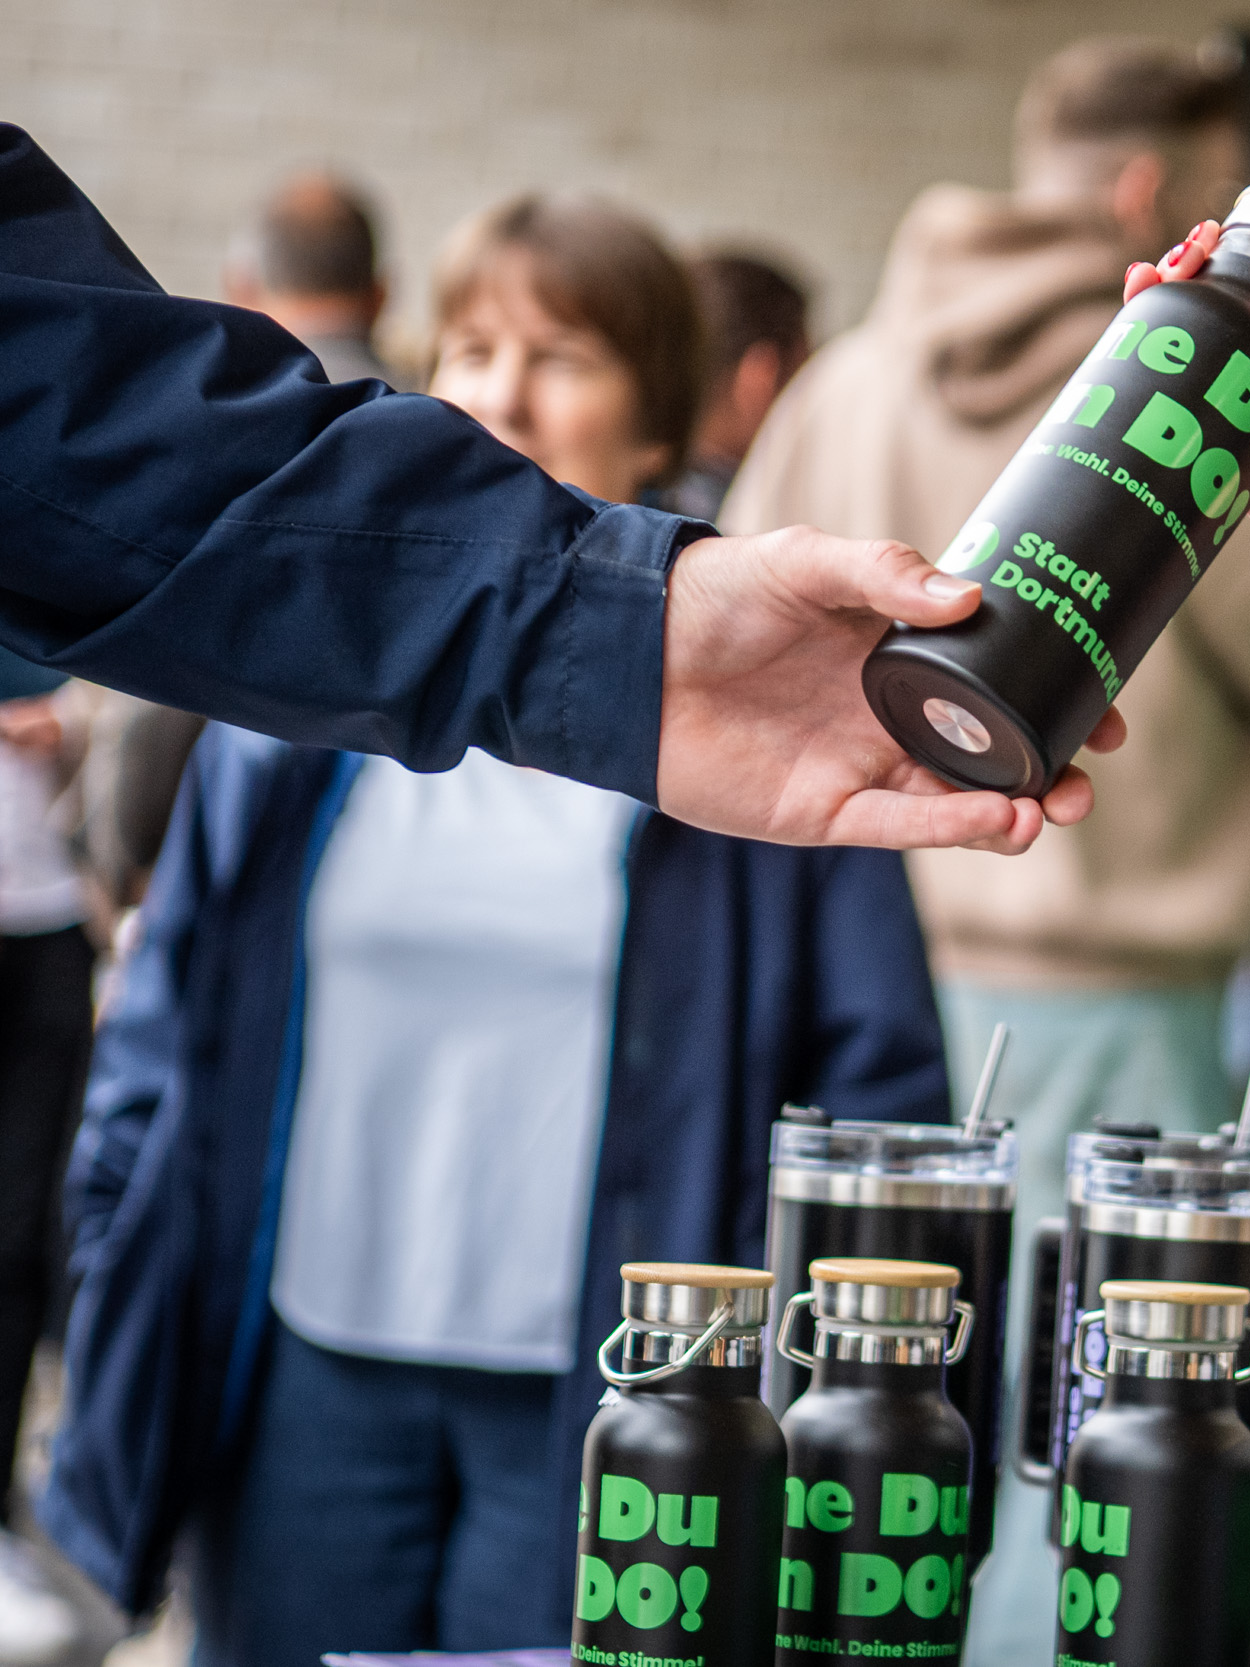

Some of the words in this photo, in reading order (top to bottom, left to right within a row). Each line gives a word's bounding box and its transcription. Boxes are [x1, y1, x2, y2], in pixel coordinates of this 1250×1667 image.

[1056, 443, 1110, 477] Wahl.
[1111, 466, 1165, 516] Deine
[1121, 391, 1250, 546] DO!
[1013, 532, 1111, 612] Stadt
[990, 559, 1124, 705] Dortmund
[598, 1474, 719, 1548] Du
[879, 1473, 968, 1538] Du
[576, 1553, 710, 1633] DO!
[837, 1552, 963, 1619] DO!
[1060, 1567, 1122, 1638] O!
[578, 1645, 617, 1666] Deine
[794, 1634, 845, 1655] Wahl.
[848, 1639, 903, 1658] Deine
